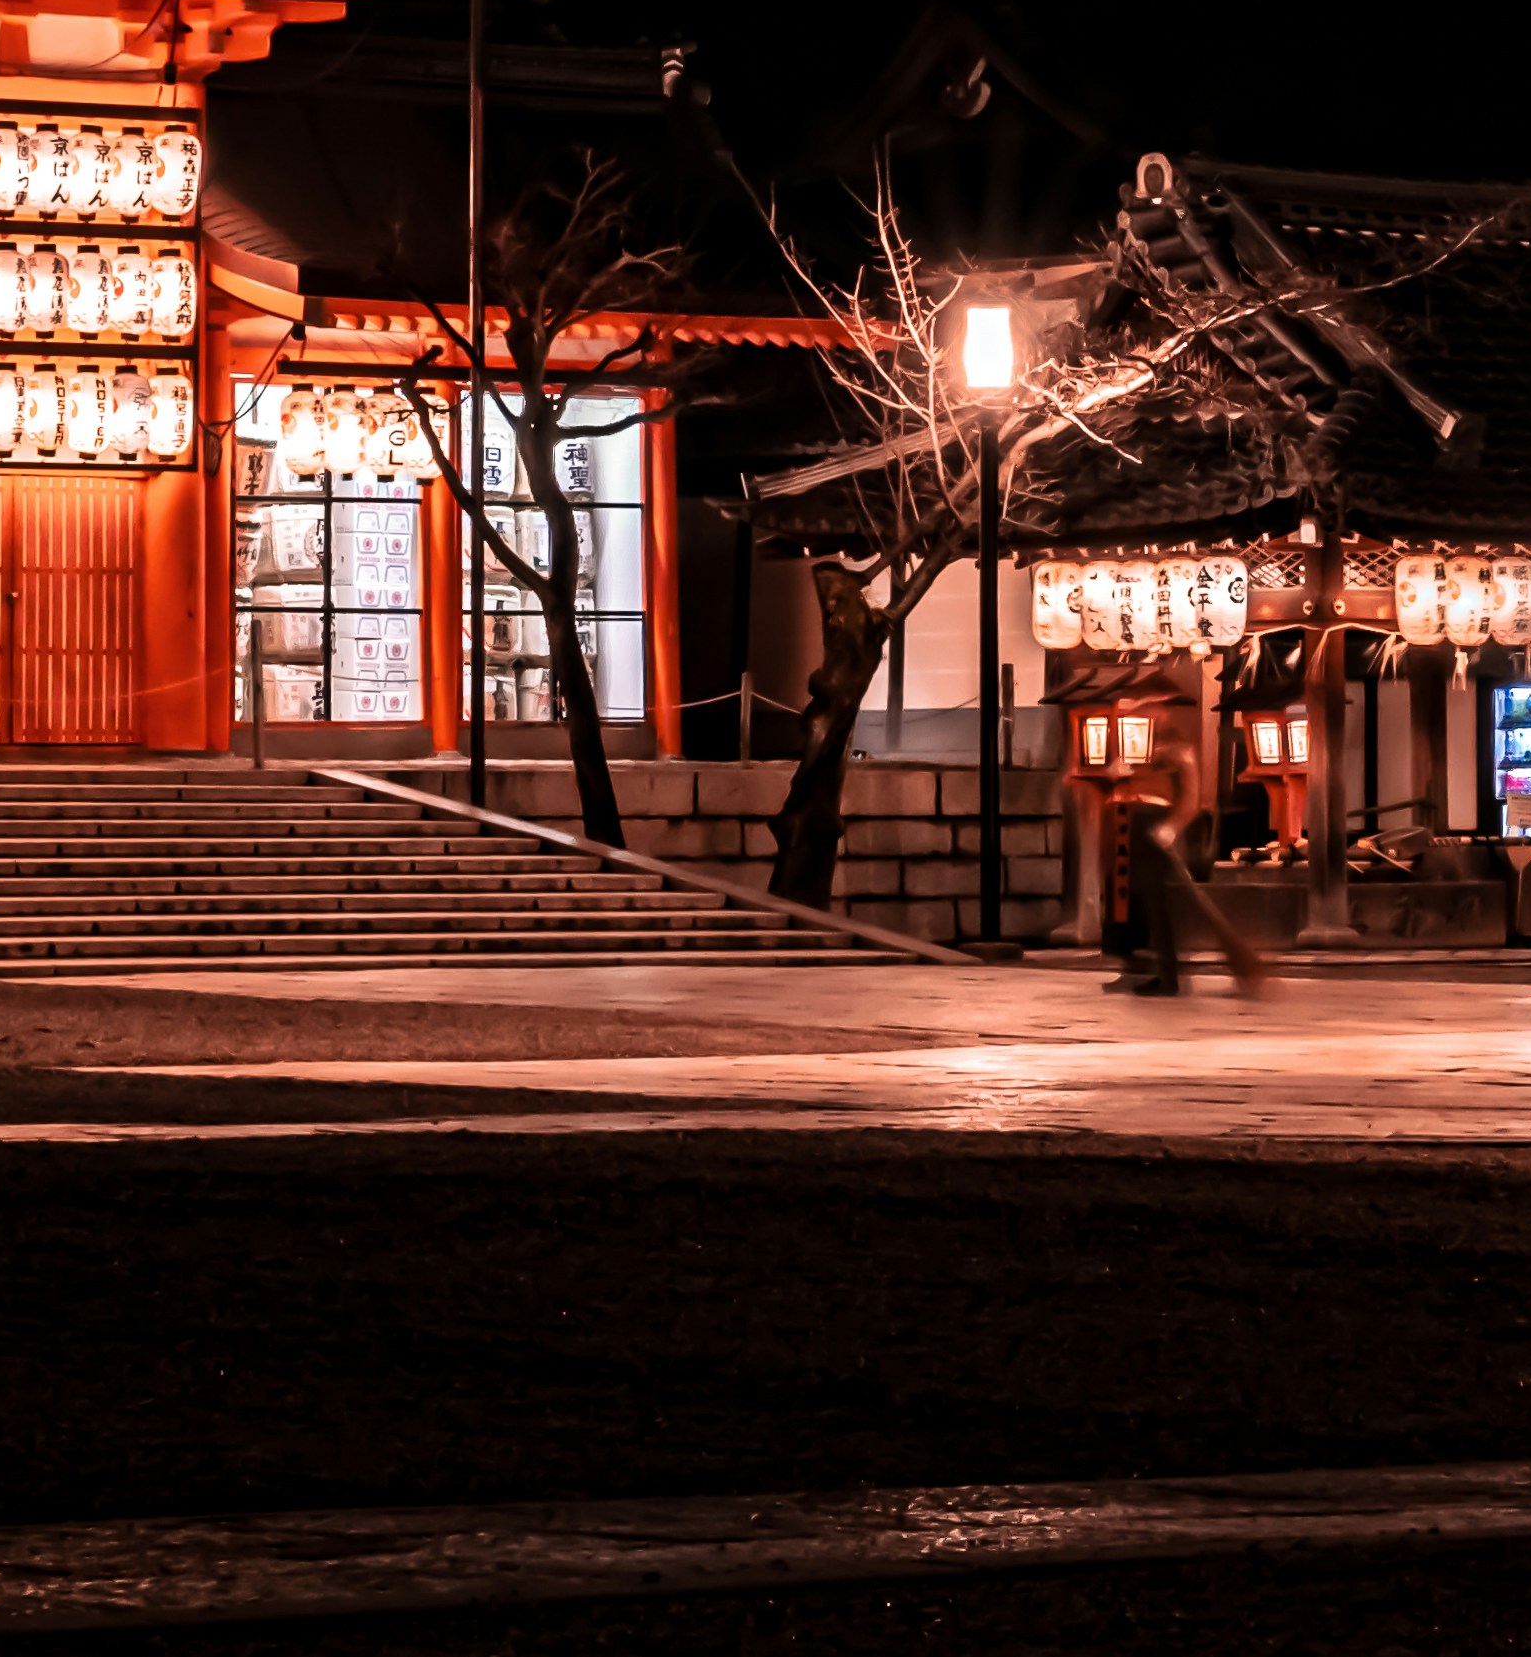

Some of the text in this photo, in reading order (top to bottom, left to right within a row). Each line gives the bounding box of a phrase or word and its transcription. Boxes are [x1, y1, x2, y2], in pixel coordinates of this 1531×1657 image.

[53, 375, 67, 446] NOSTER
[94, 378, 109, 448] NOSTER
[564, 443, 591, 493] 神聖
